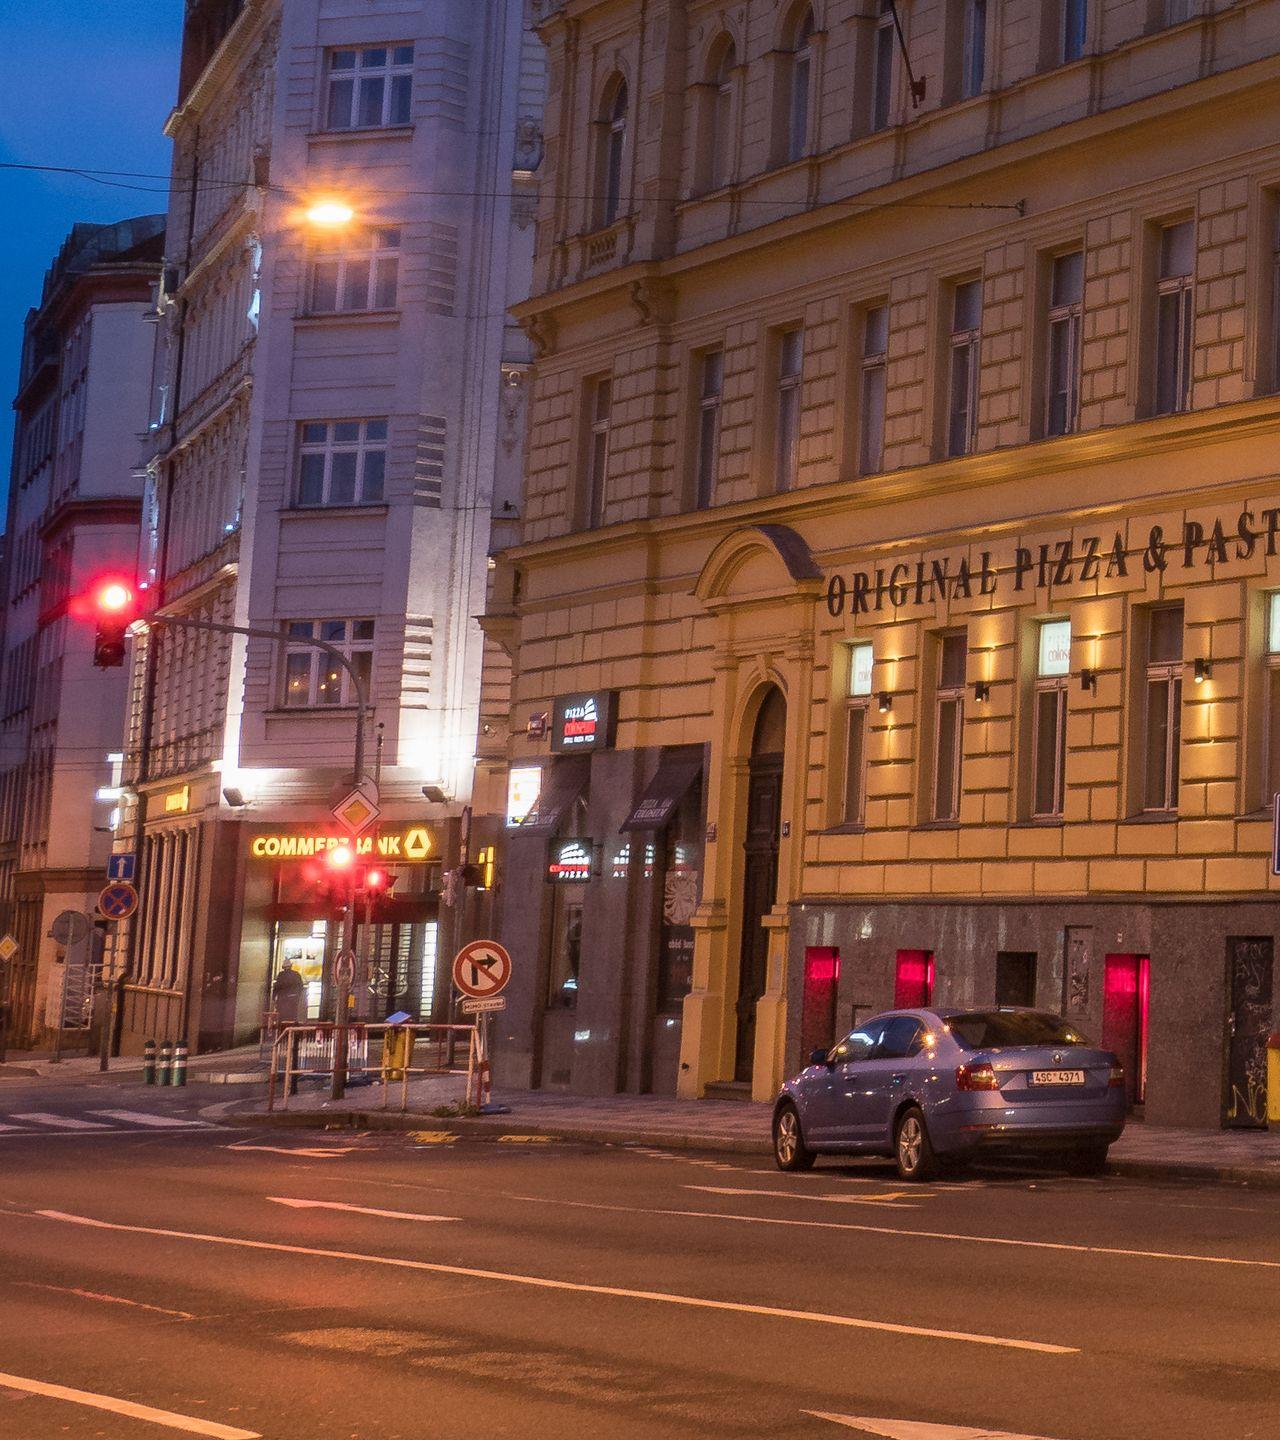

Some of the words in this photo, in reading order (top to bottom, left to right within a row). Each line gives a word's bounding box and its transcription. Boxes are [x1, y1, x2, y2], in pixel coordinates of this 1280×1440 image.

[826, 550, 998, 618] ORIGINAL
[1013, 530, 1129, 592] PIZZA
[1143, 524, 1167, 573] &
[1058, 1071, 1081, 1082] 4371
